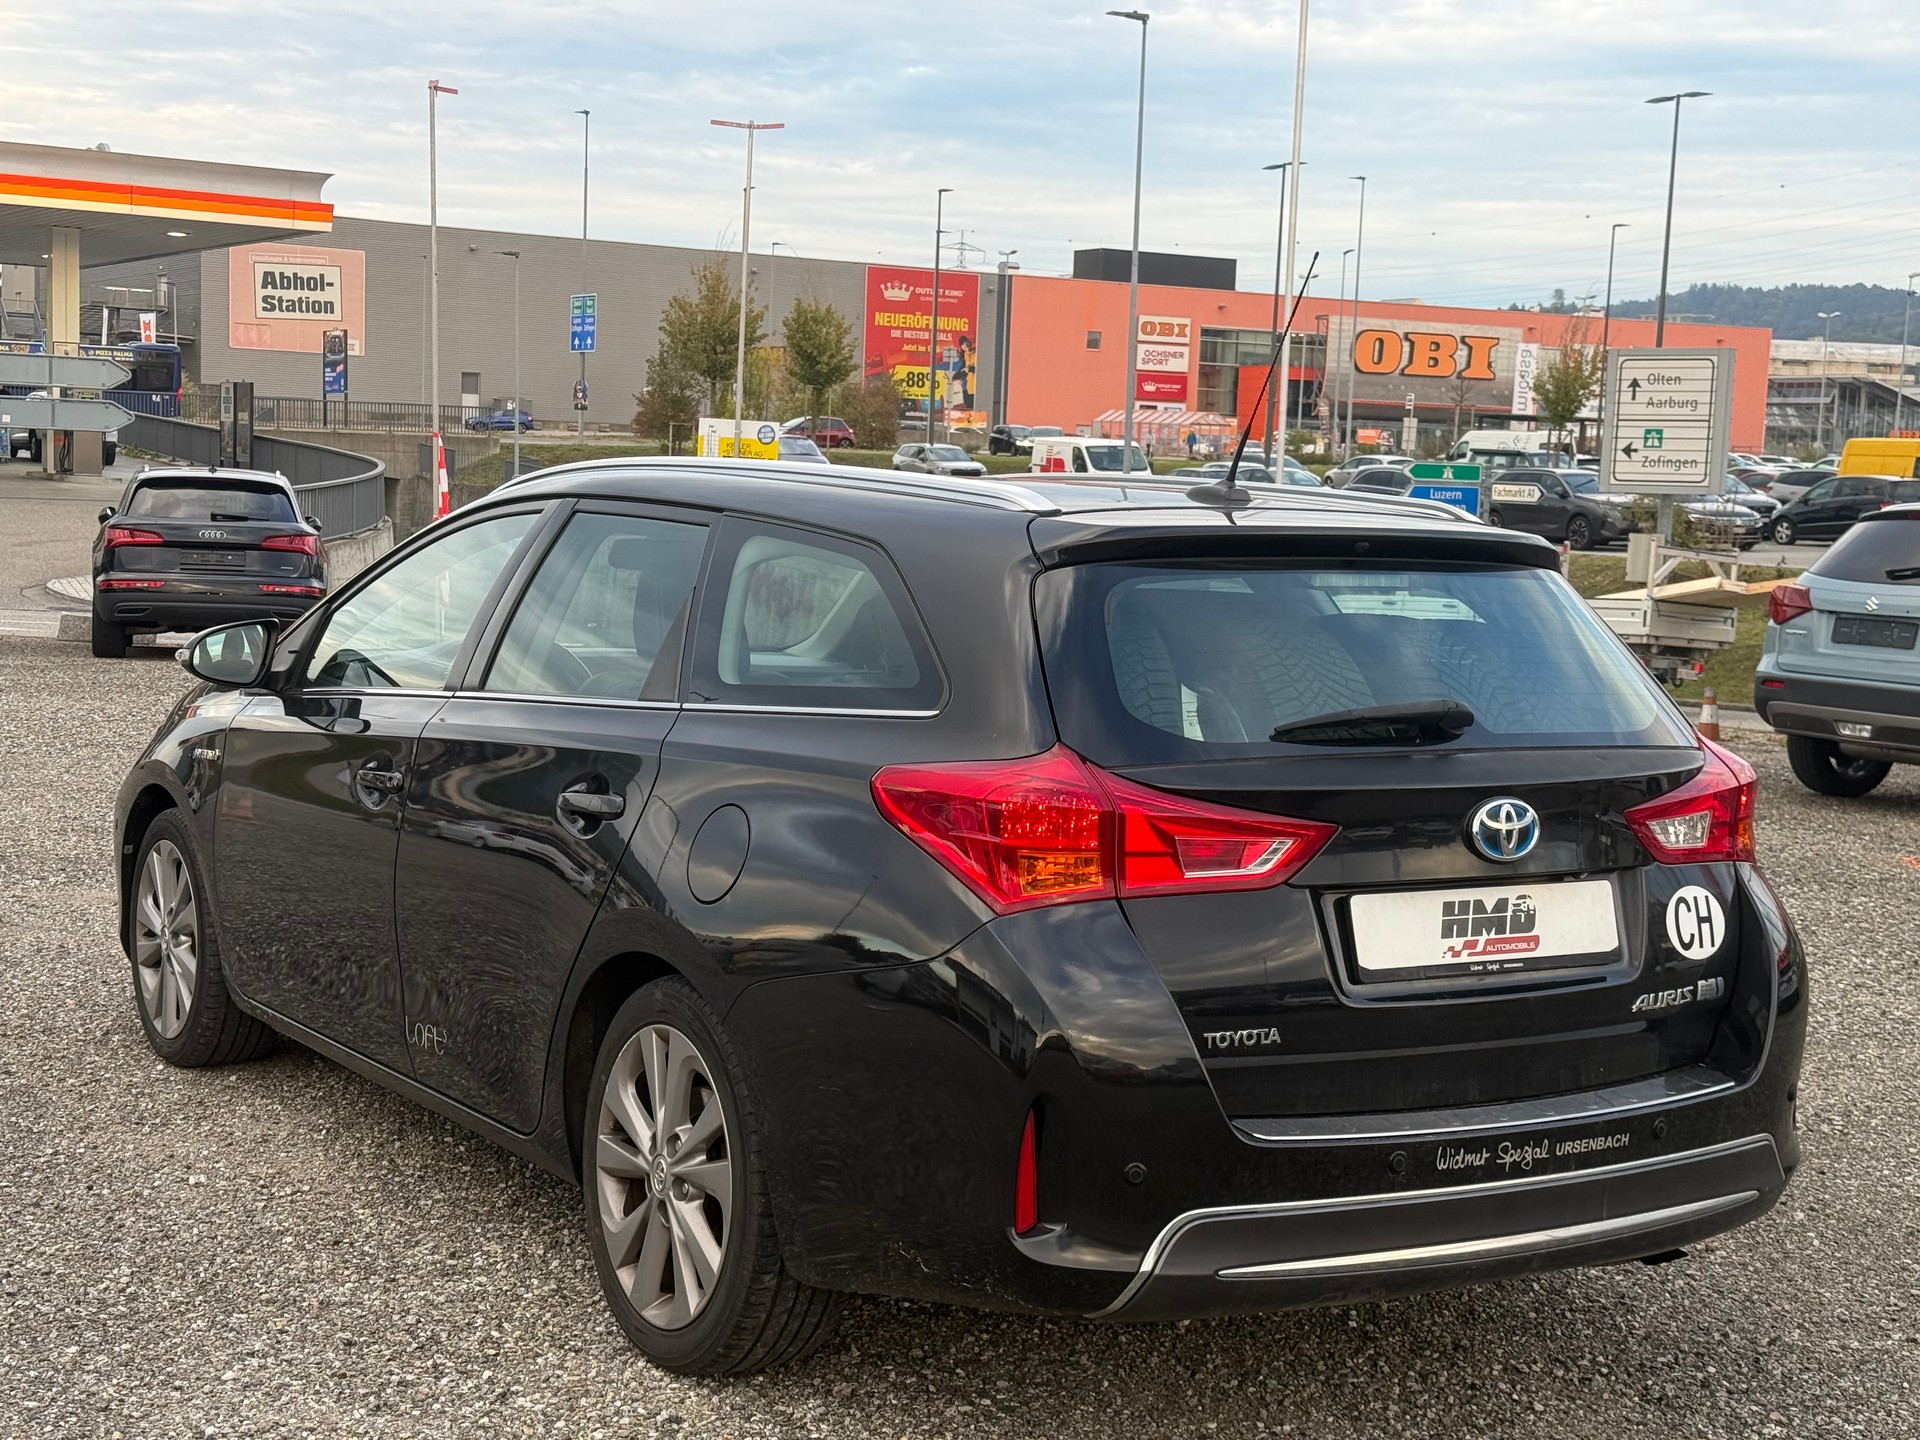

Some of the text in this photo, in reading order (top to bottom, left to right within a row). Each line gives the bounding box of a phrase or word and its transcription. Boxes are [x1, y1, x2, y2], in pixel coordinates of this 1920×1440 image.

[261, 271, 334, 292] Abhol-
[915, 287, 944, 296] OUTLT
[262, 295, 334, 314] Station
[875, 312, 969, 332] NEUERÖFNUNG
[1140, 321, 1189, 338] OBI
[890, 329, 953, 341] DIE BESTEN EALS
[1141, 357, 1170, 366] SPORT
[1144, 349, 1185, 359] OCHSNER
[1354, 329, 1500, 380] OBI
[1647, 372, 1682, 386] Olten
[1645, 396, 1698, 412] Aarburg
[1641, 455, 1698, 471] Zofingen
[1430, 488, 1462, 500] Luzern
[1493, 487, 1535, 498] Fachmarkt A1
[1674, 895, 1715, 951] CH
[1486, 941, 1536, 952] AUTOMOBILE
[1631, 985, 1694, 1013] AURIS
[1203, 1027, 1281, 1049] TOYOTA
[1556, 1133, 1630, 1156] URSENBACH
